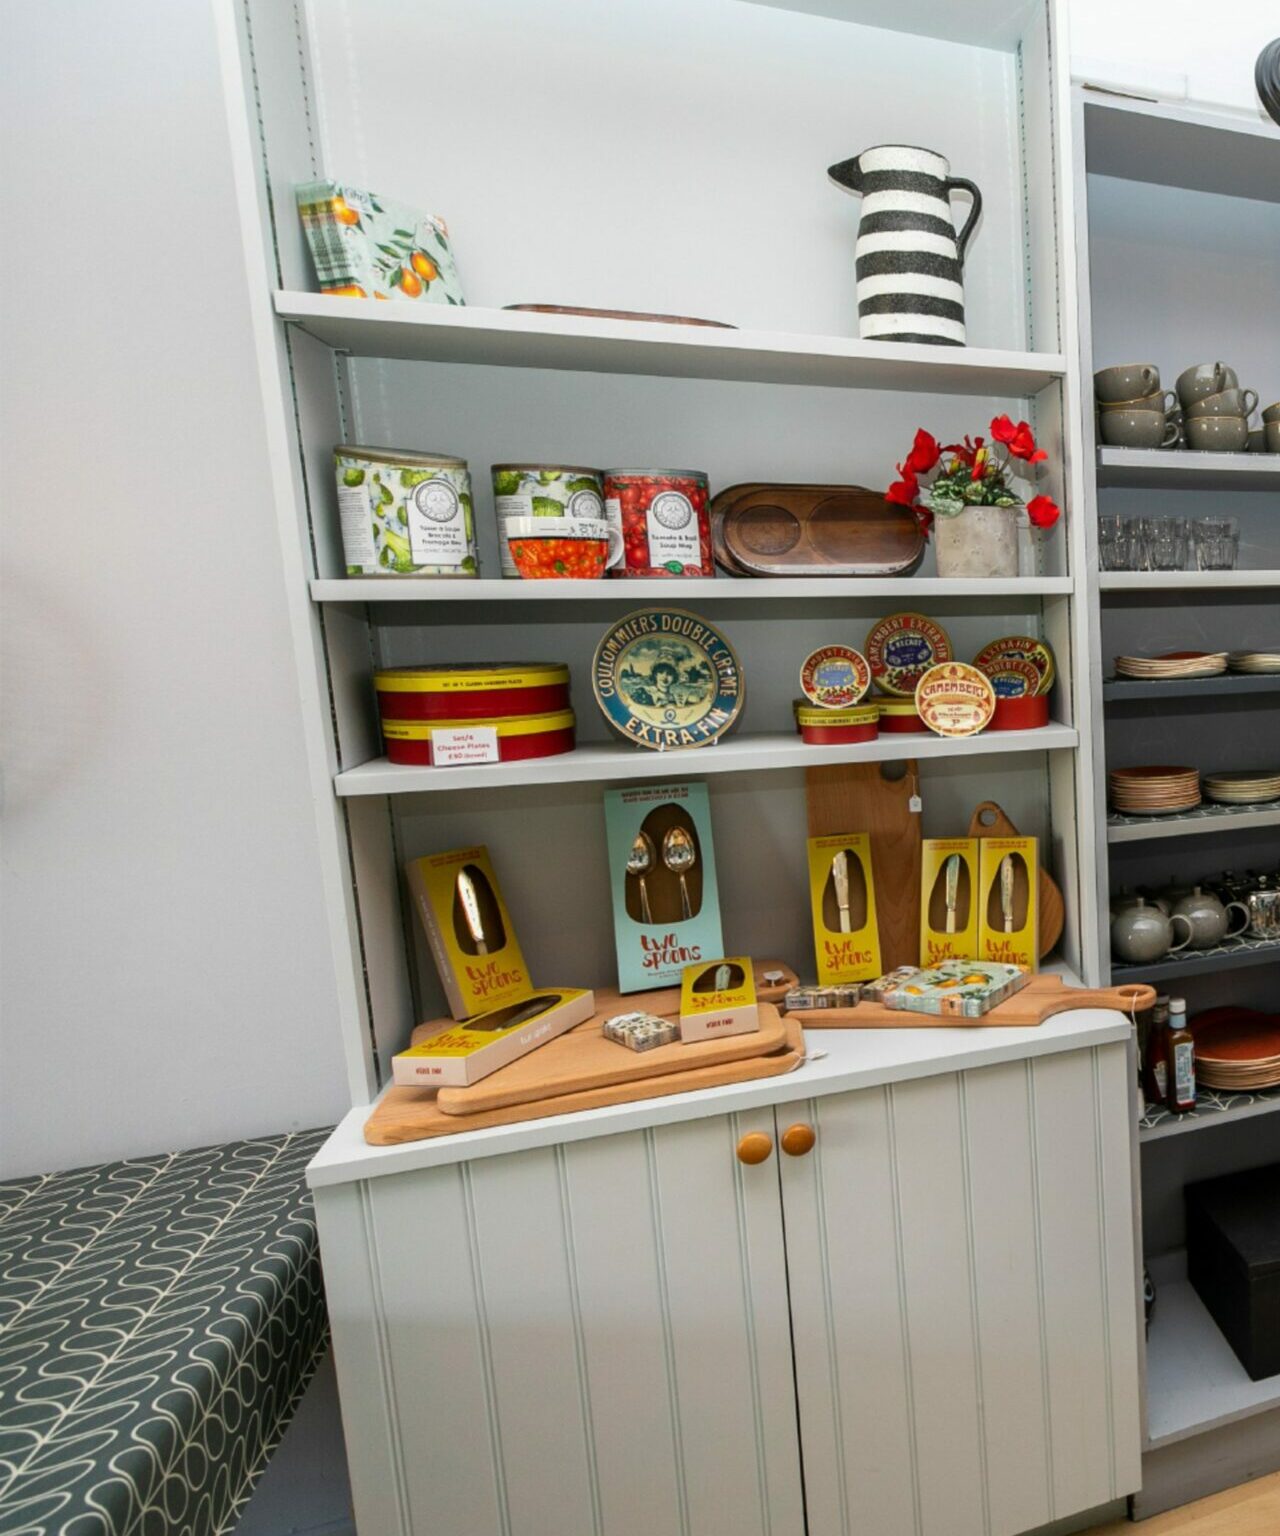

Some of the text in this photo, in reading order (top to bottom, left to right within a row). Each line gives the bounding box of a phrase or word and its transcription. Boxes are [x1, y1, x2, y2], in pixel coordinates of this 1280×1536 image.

[868, 617, 903, 669] CAMEMBERT
[910, 618, 942, 643] EXTRA
[598, 614, 658, 697] COULOMMIERS
[661, 614, 718, 651] DOUBLE
[923, 682, 984, 697] CAMEMBERT
[625, 707, 729, 745] EXTRA FIN
[437, 742, 490, 752] Cheese Plates
[640, 933, 679, 952] two
[642, 946, 702, 970] spoons
[826, 951, 873, 971] spoons
[465, 961, 499, 981] two
[472, 969, 523, 996] spoons
